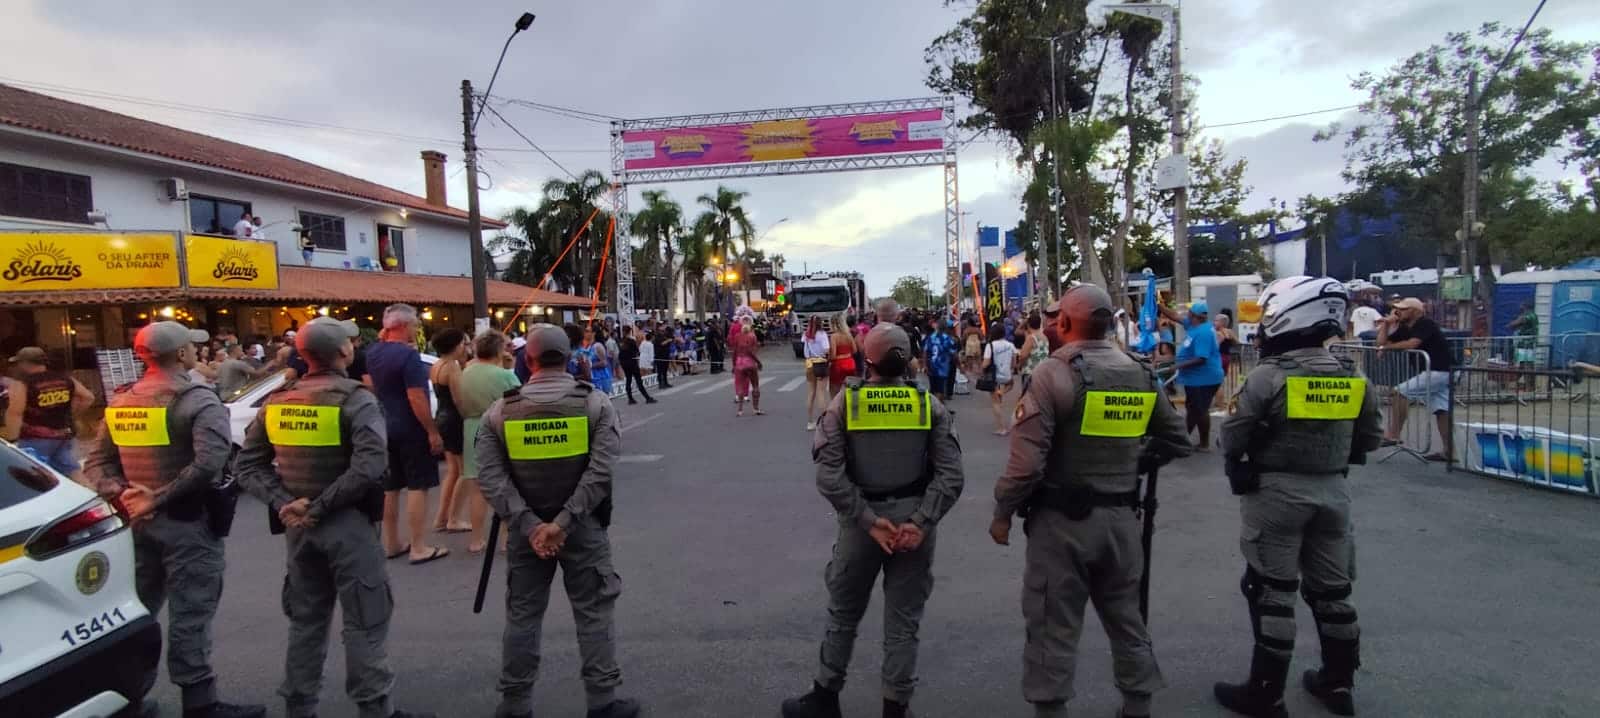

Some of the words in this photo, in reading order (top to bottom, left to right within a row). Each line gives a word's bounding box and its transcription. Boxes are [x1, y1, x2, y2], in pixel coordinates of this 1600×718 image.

[98, 253, 108, 262] O
[111, 253, 132, 261] SEU
[135, 252, 170, 261] AFTER
[2, 260, 83, 281] Solaris
[106, 261, 123, 270] DA
[212, 261, 259, 280] Solaris
[1306, 381, 1352, 390] BRIGADA
[866, 390, 911, 399] BRIGADA
[1304, 393, 1350, 404] MILITAR
[1103, 396, 1144, 406] BRIGADA
[280, 408, 319, 418] BRIGADA
[867, 403, 913, 414] MILITAR
[114, 411, 149, 420] BRIGADA
[1103, 410, 1143, 420] MILITAR
[114, 422, 148, 432] MILITAR
[278, 421, 318, 432] MILITAR
[523, 420, 569, 432] BRIGADA
[523, 433, 568, 446] MILITAR
[61, 607, 127, 647] 15411
